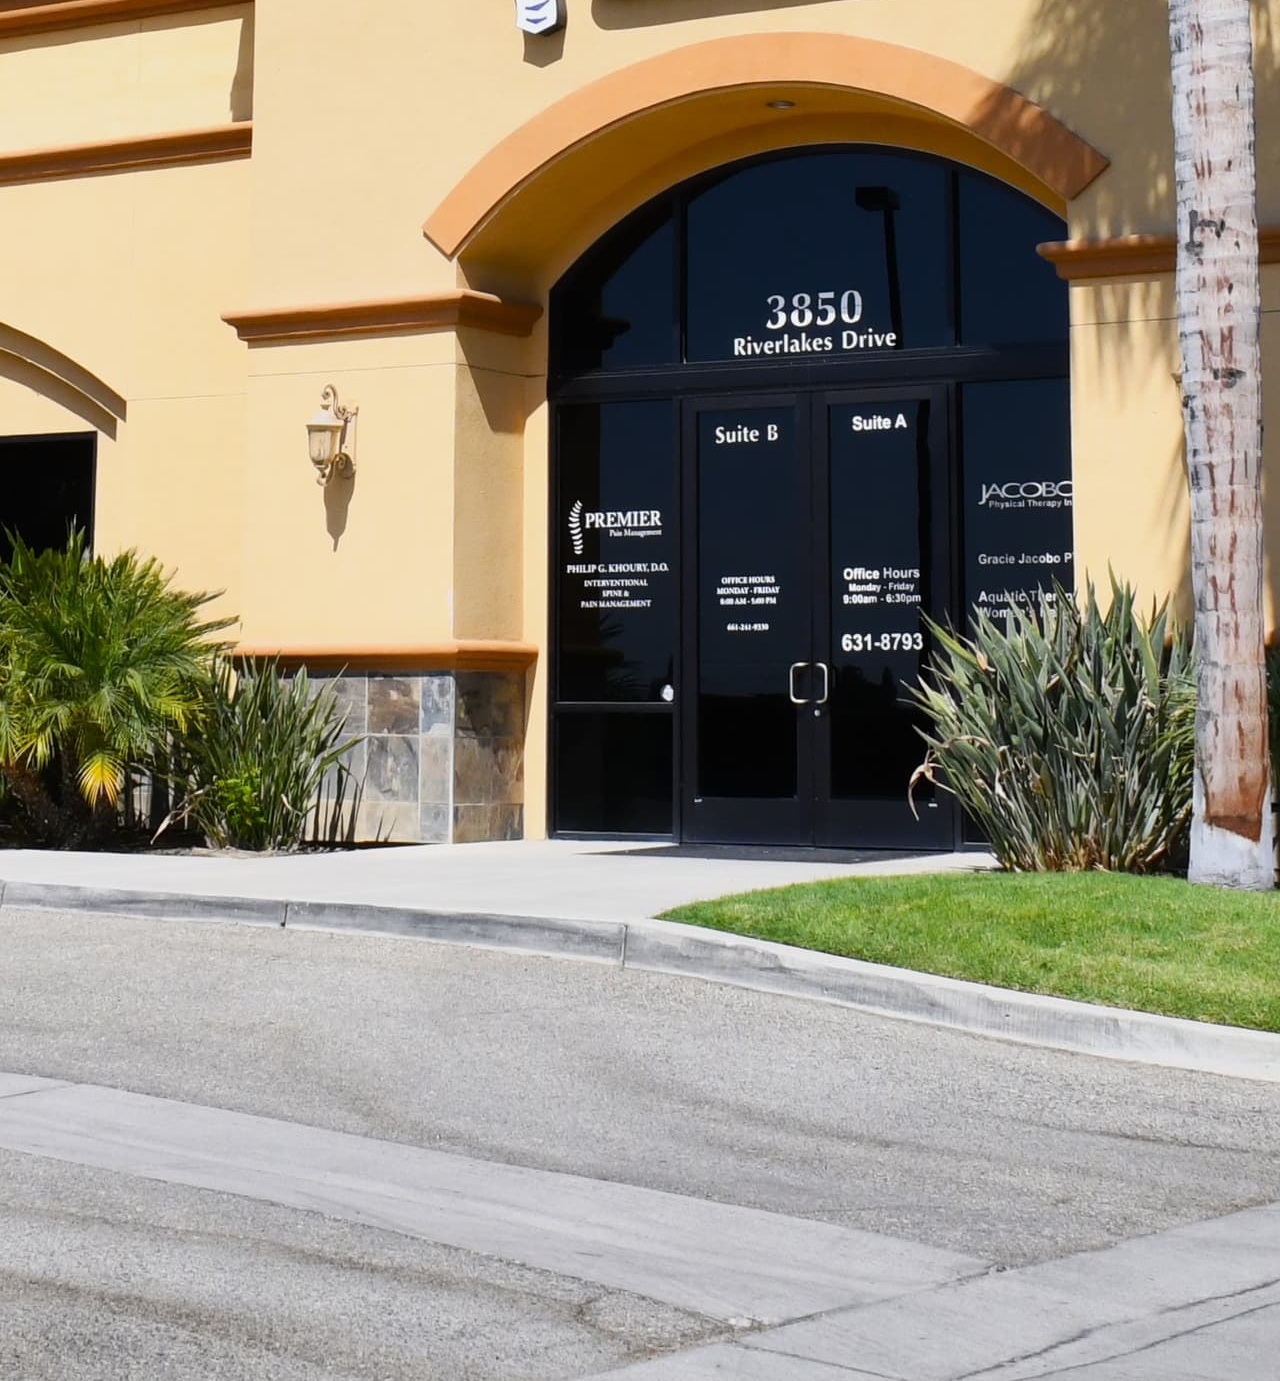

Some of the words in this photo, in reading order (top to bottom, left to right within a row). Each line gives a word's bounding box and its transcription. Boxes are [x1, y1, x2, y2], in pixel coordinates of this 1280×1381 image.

[766, 289, 863, 329] 3850
[733, 332, 833, 356] Riverlakes
[841, 328, 897, 350] Drive
[851, 415, 892, 431] Suite
[894, 413, 908, 429] A
[714, 424, 760, 444] Suite
[767, 423, 779, 441] B
[988, 499, 1025, 510] Physical
[1027, 498, 1062, 508] Therapy
[584, 510, 663, 529] PREMIER
[978, 553, 1015, 565] Gracie
[1018, 552, 1061, 565] Jacobo
[566, 564, 597, 573] PHILIP
[608, 563, 650, 573] KHOURY,
[843, 567, 880, 580] Office
[882, 566, 920, 579] Hours
[583, 578, 648, 587] INTERVENTIONAL
[721, 576, 748, 585] OFFICE
[748, 575, 776, 584] HOURS
[716, 586, 750, 595] MONDAY
[753, 585, 780, 594] FRIDAY
[848, 582, 881, 593] Monday
[888, 581, 915, 592] Friday
[580, 600, 598, 609] PAIN
[598, 599, 652, 608] MANAGEMENT
[885, 593, 922, 605] 6:30pm
[841, 632, 924, 651] 631-8793
